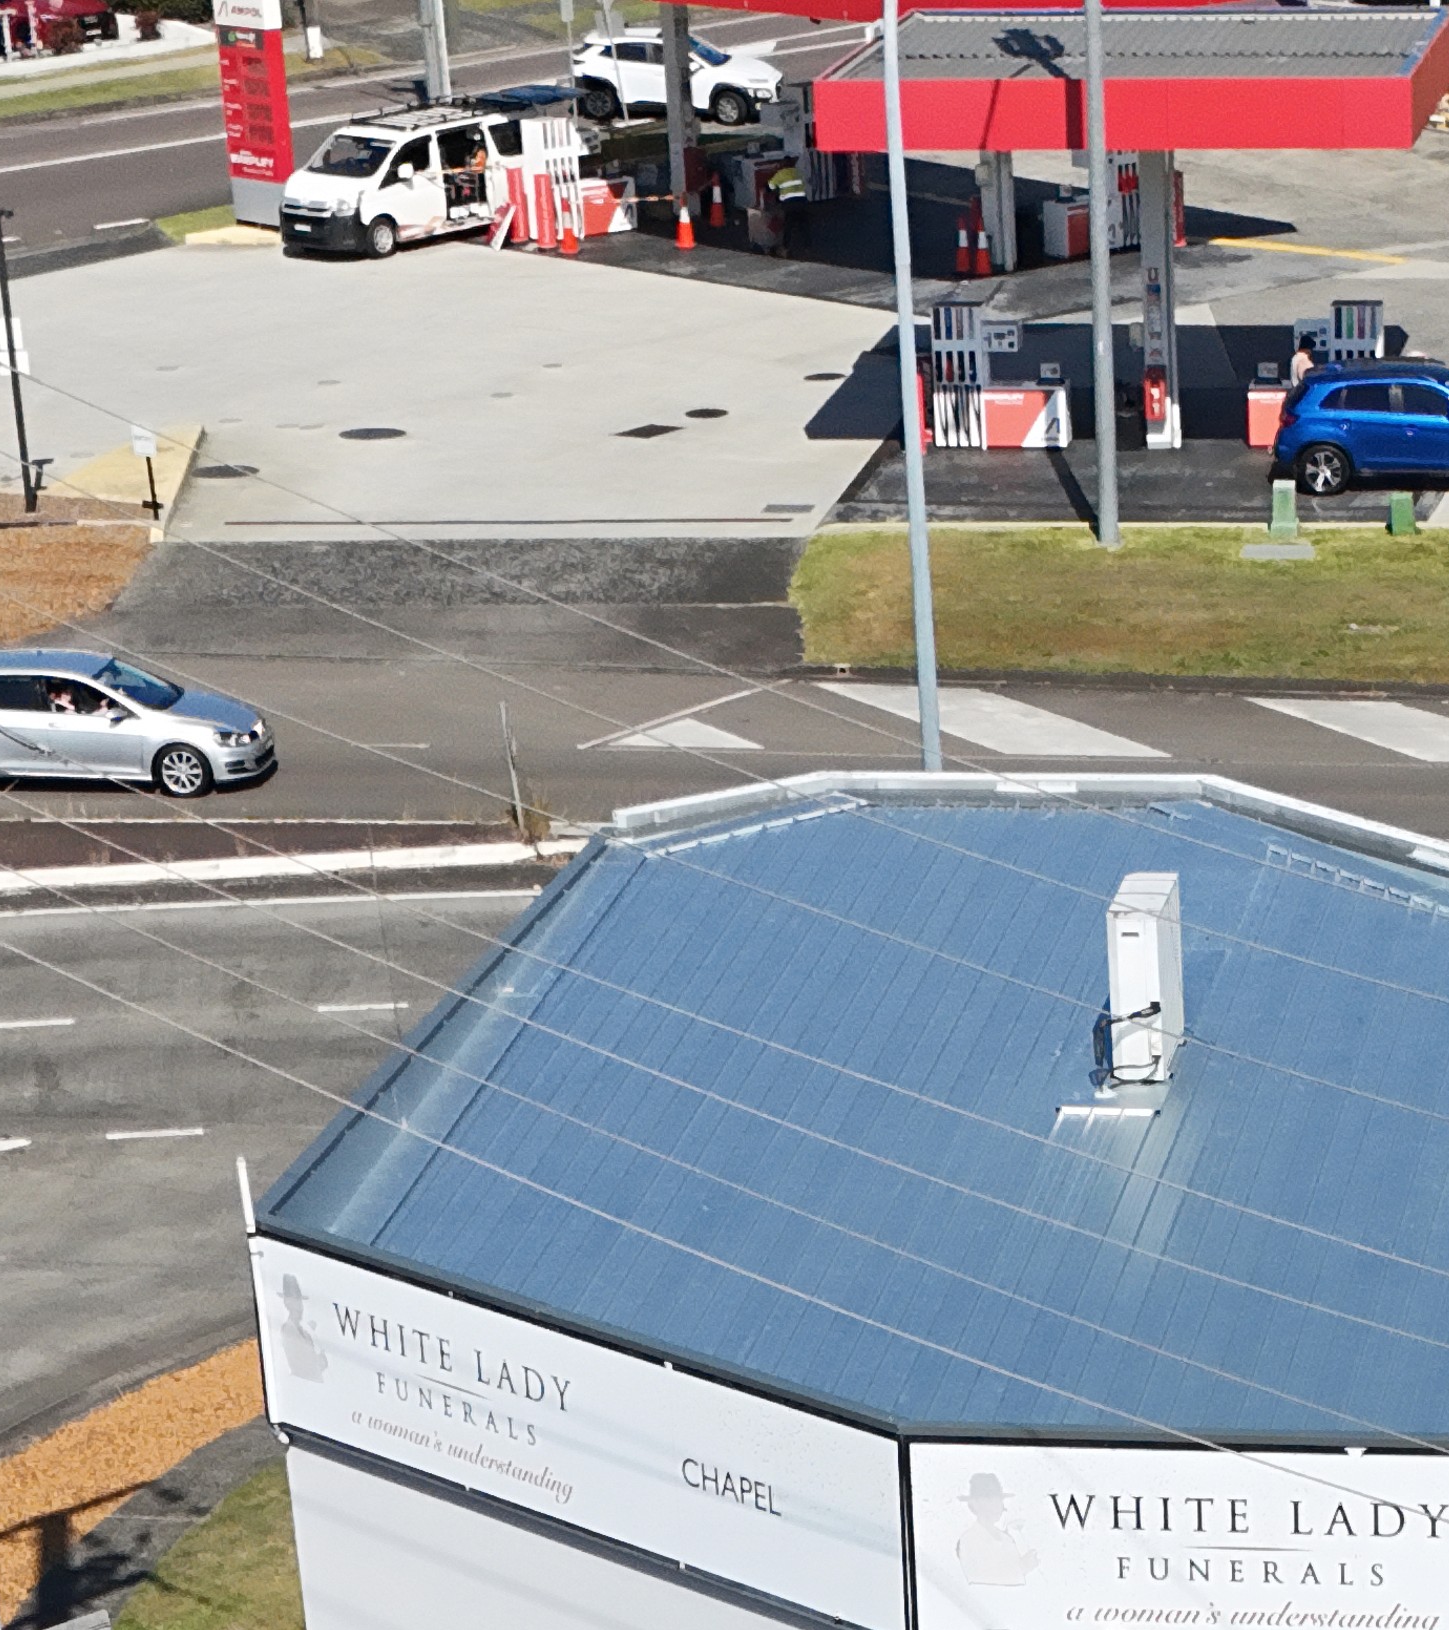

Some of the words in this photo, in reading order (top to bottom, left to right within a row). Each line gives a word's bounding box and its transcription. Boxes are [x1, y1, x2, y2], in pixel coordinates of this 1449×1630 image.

[332, 1302, 453, 1373] WHITE
[474, 1348, 572, 1413] LADY
[376, 1371, 538, 1447] FUNERALS
[351, 1410, 363, 1425] a
[367, 1416, 443, 1453] woman's
[447, 1443, 574, 1505] understanding
[681, 1457, 783, 1517] CHAPEL
[1048, 1493, 1250, 1535] WHITE
[1116, 1556, 1385, 1588] FUNERALS
[1065, 1605, 1085, 1622] a
[1093, 1601, 1223, 1626] woman's
